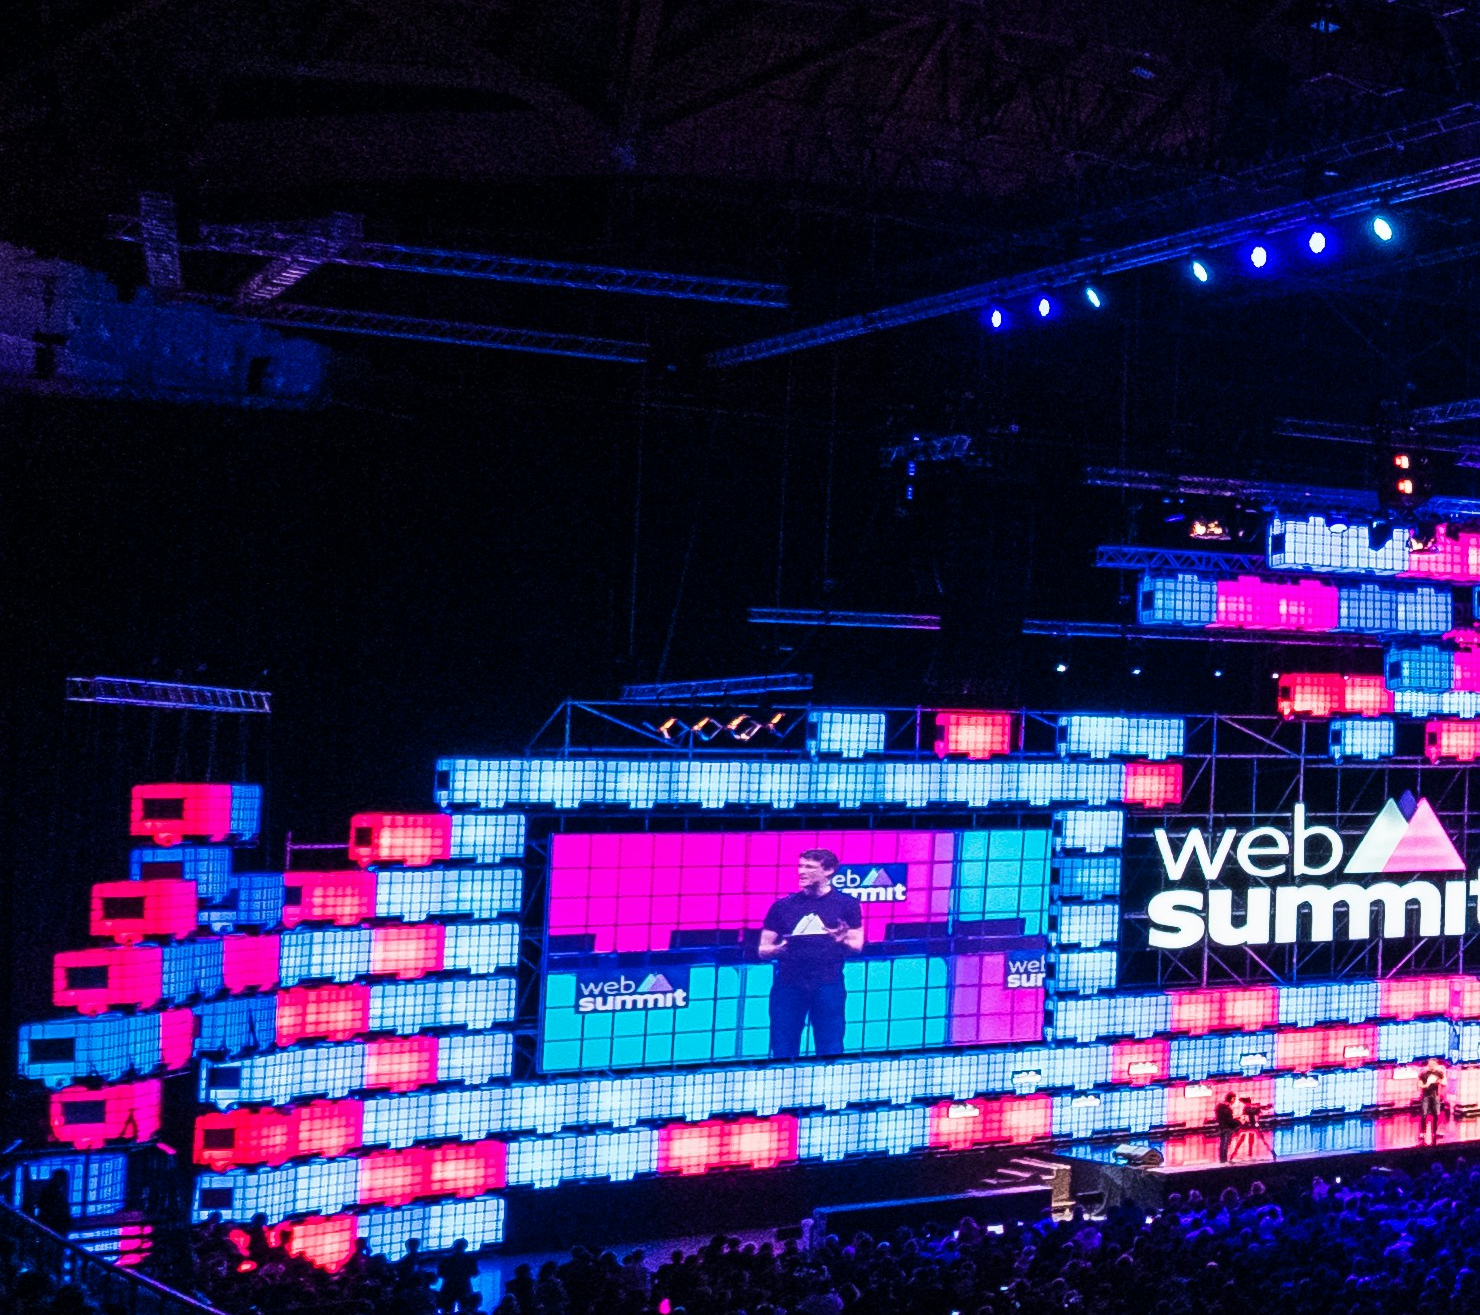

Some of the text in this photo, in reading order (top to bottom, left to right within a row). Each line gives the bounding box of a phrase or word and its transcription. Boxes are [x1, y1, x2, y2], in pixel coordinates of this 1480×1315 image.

[1154, 803, 1343, 881] web
[831, 868, 861, 888] eb
[1008, 954, 1046, 974] we
[580, 974, 636, 996] web
[578, 988, 687, 1012] summit
